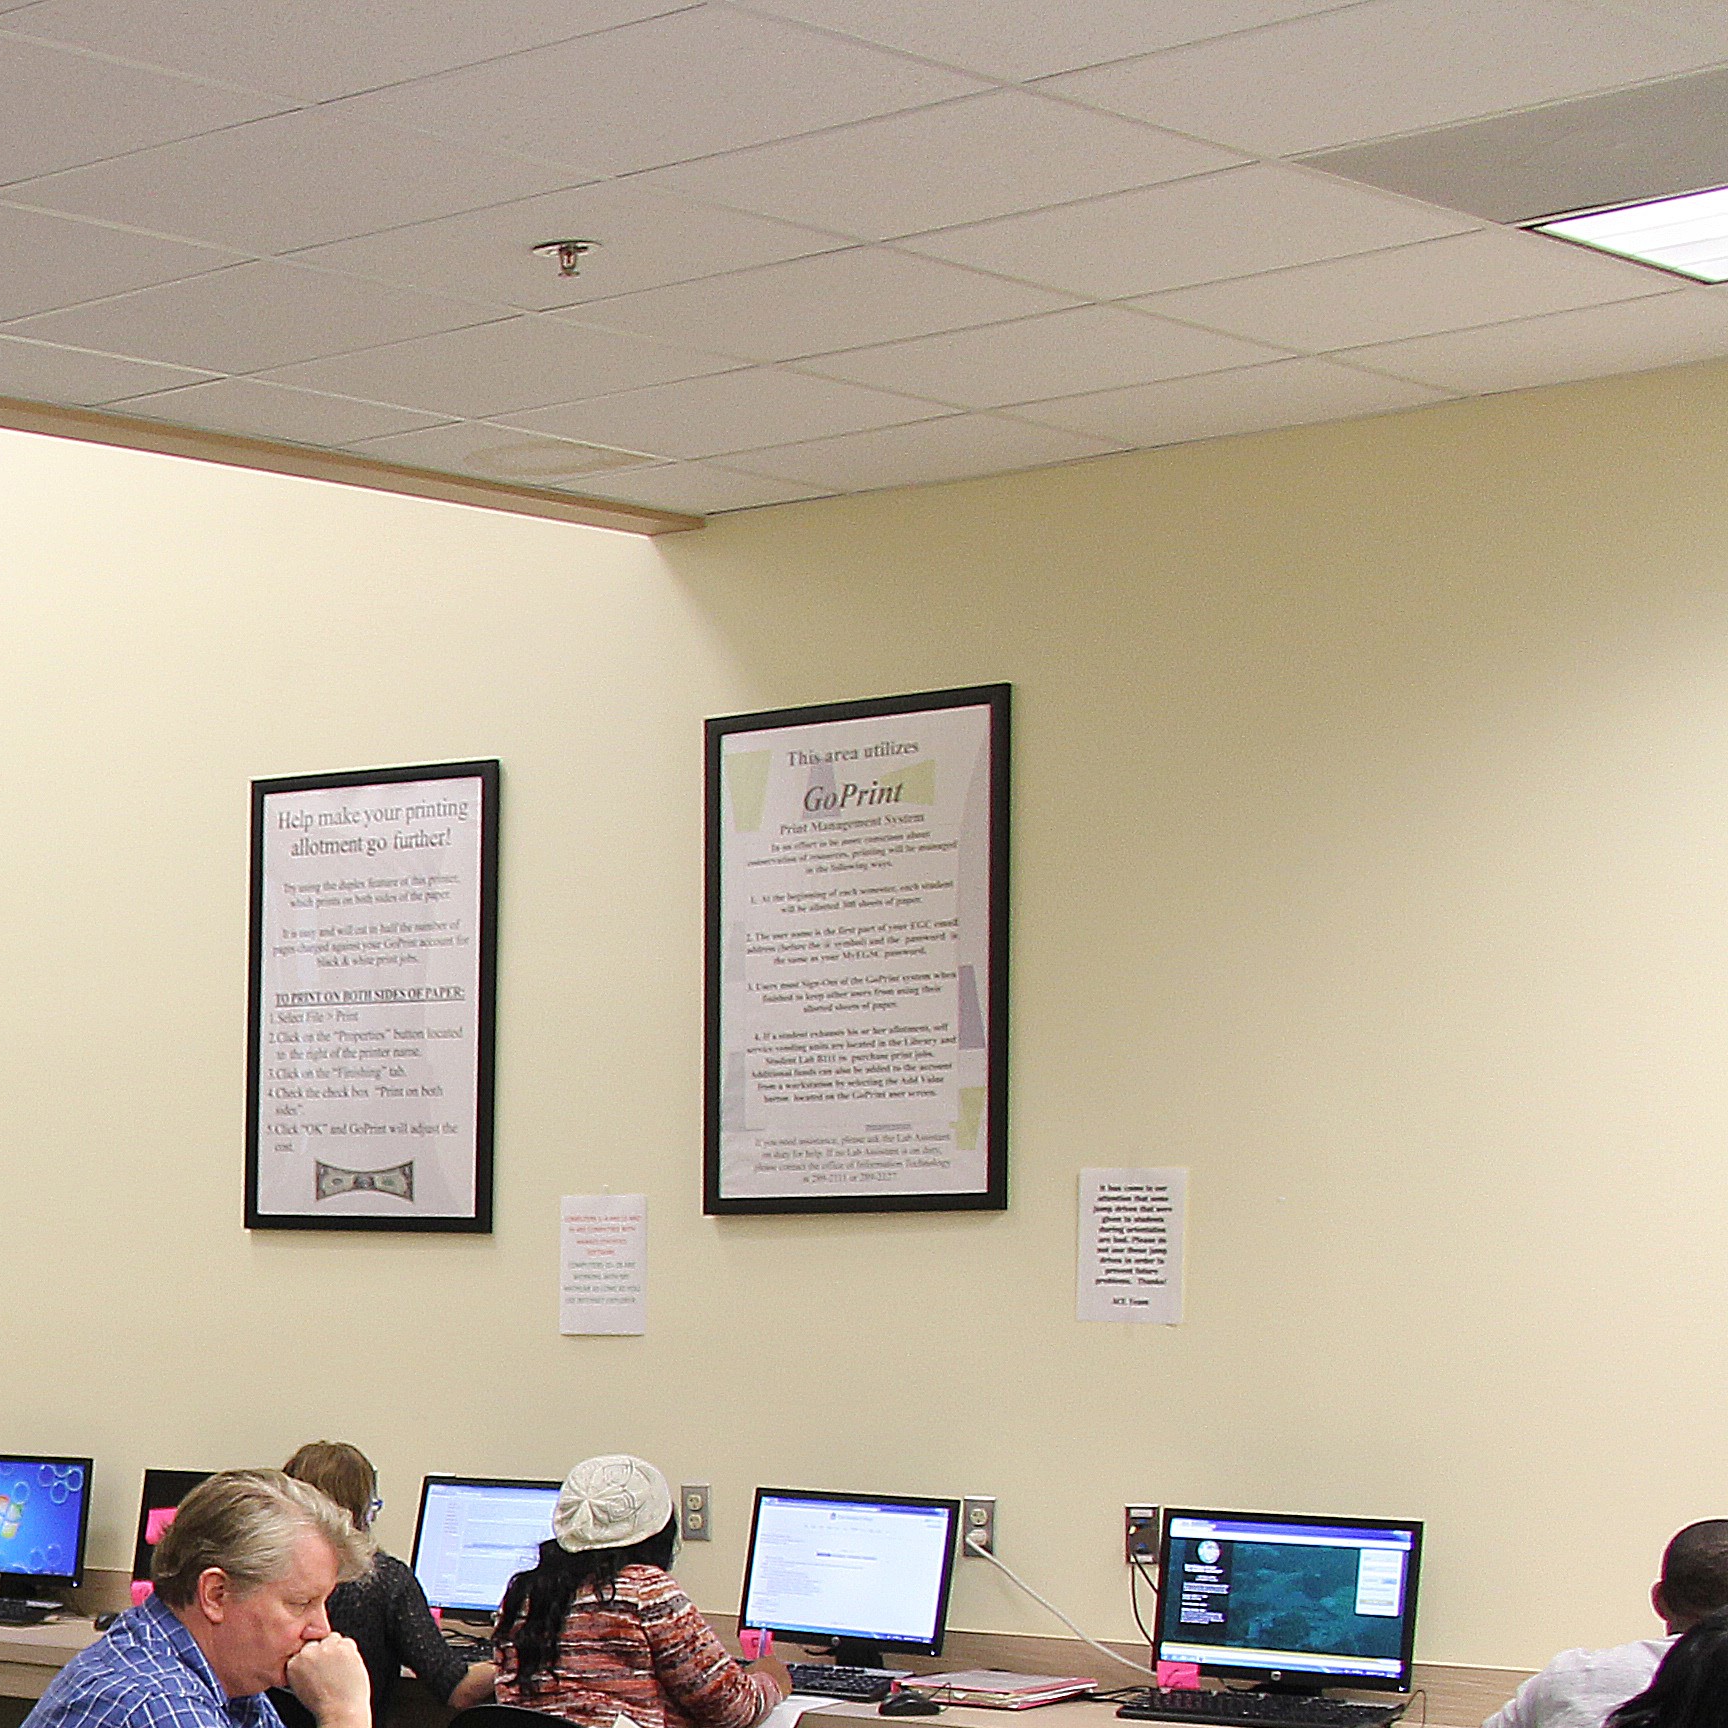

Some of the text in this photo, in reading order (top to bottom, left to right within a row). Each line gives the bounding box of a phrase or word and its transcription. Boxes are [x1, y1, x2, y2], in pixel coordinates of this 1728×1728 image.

[788, 741, 919, 767] This area utilizes
[803, 781, 902, 811] GoPrint
[278, 798, 468, 833] Help make your printing
[779, 813, 925, 835] Print Management System
[291, 827, 451, 857] allotment go further!
[290, 991, 321, 1005] PRINT
[323, 990, 340, 1004] ON
[342, 989, 372, 1003] BOTH
[373, 988, 406, 1002] SIDES
[407, 987, 424, 1001] OF
